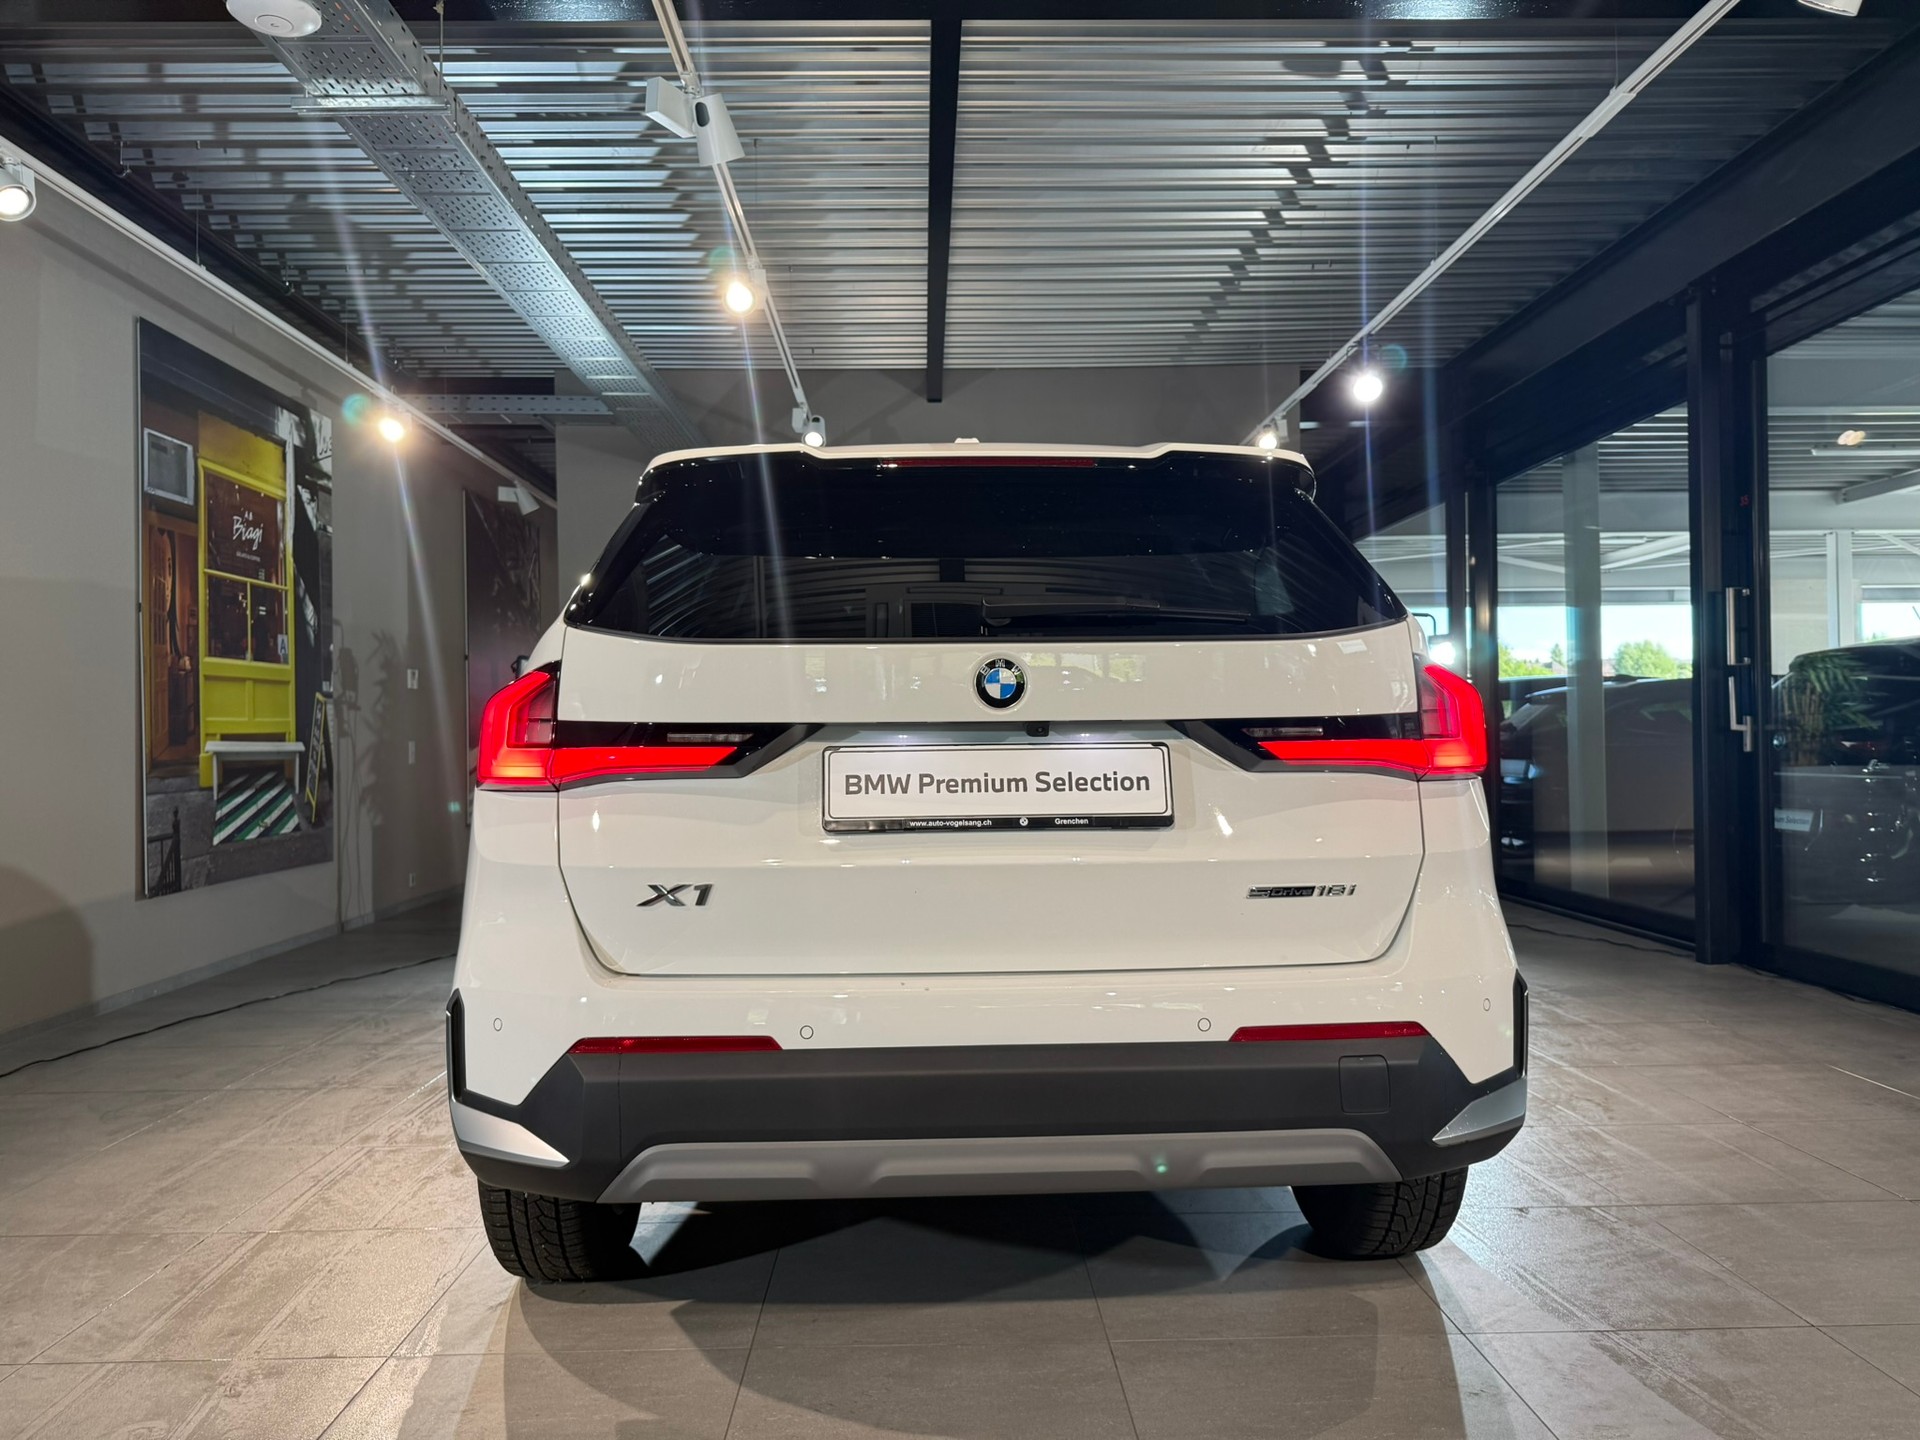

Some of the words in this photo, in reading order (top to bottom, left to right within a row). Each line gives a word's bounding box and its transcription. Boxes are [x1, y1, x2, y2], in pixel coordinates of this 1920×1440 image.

[232, 515, 264, 551] Biagi
[979, 658, 1022, 676] BMW
[844, 773, 911, 796] BMW
[918, 771, 1028, 795] Premium
[1034, 769, 1151, 793] Selection
[909, 819, 992, 828] www.auto-vogelsang.ch
[1054, 817, 1089, 825] Grenchen
[636, 883, 714, 907] X1
